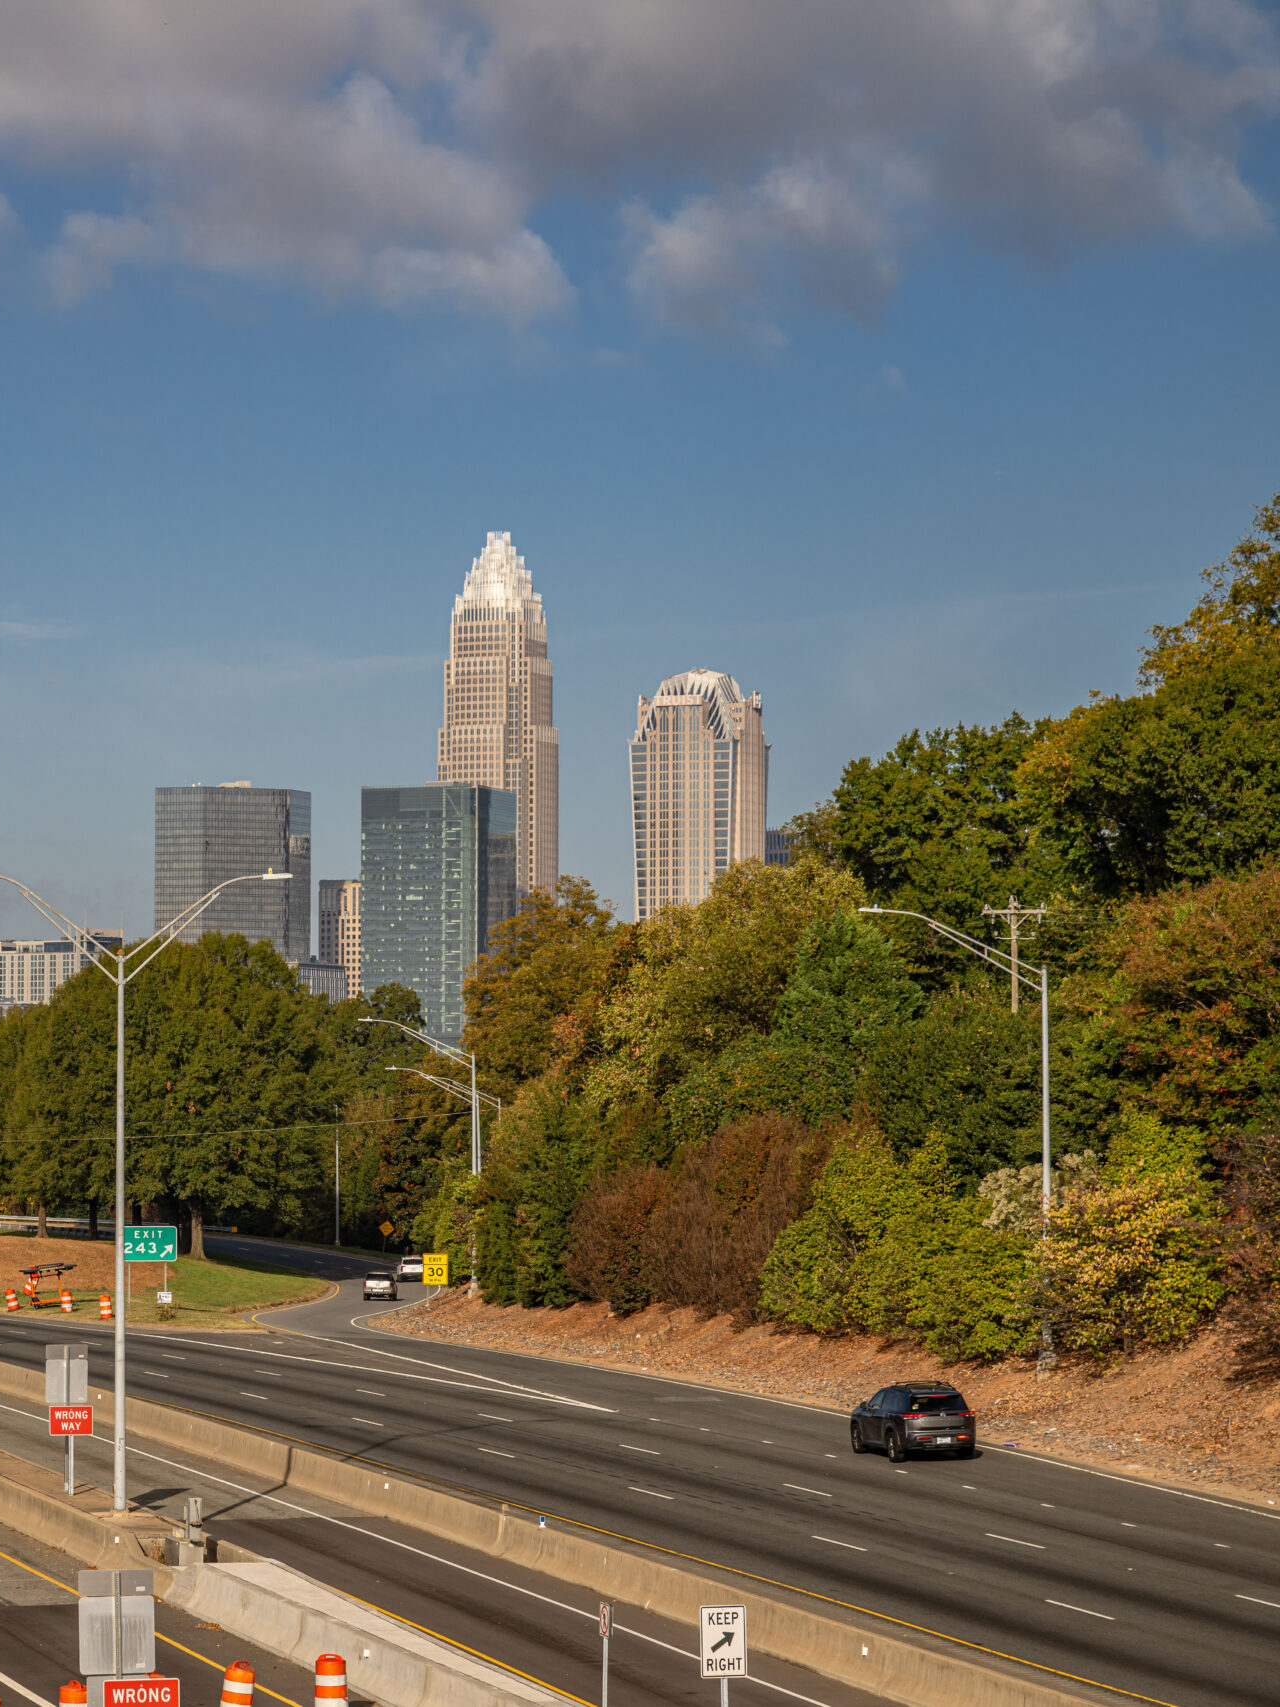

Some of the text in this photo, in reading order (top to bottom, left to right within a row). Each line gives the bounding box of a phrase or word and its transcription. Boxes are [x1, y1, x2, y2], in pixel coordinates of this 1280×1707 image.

[655, 695, 701, 705] TRUIST
[134, 1230, 163, 1239] EXIT
[124, 1242, 157, 1254] 243
[427, 1267, 444, 1277] 30
[54, 1410, 89, 1420] WRONG
[61, 1421, 82, 1431] WAY
[708, 1611, 739, 1625] KEEP
[706, 1657, 743, 1671] RIGHT
[112, 1687, 171, 1704] WRONG
